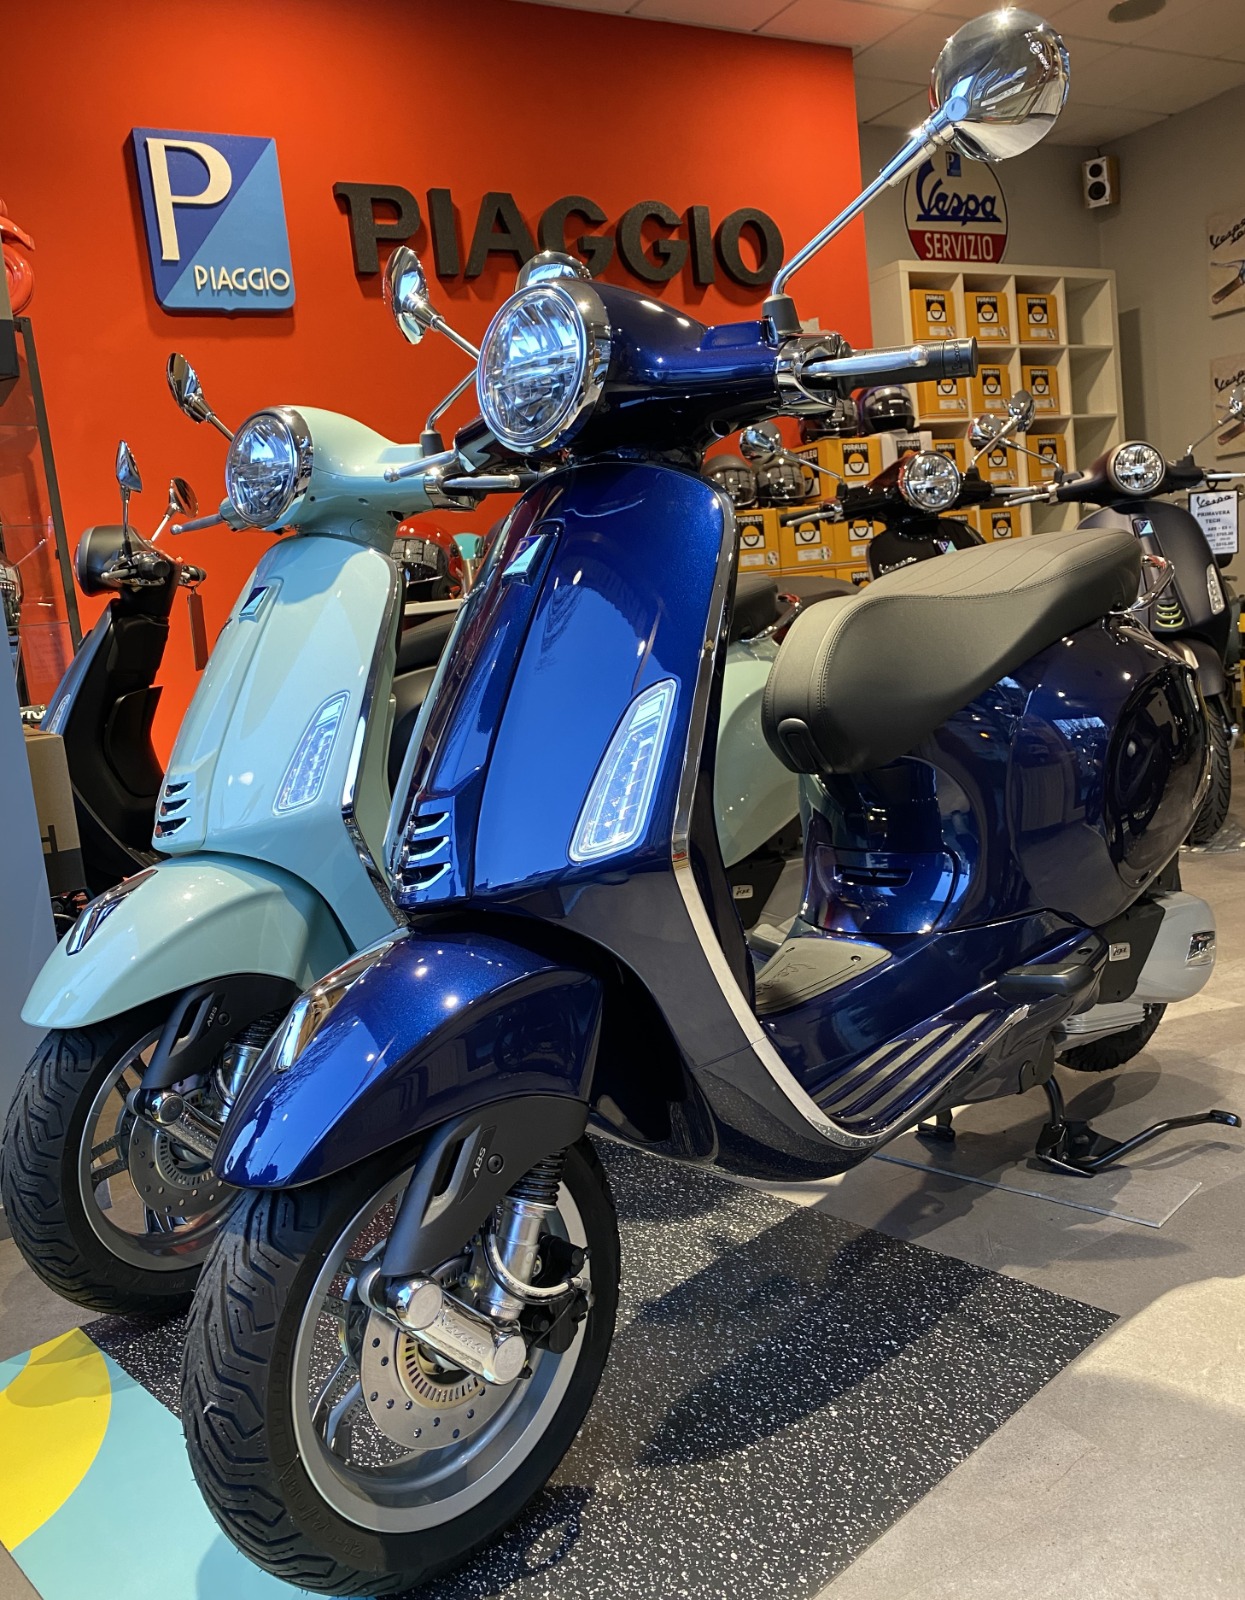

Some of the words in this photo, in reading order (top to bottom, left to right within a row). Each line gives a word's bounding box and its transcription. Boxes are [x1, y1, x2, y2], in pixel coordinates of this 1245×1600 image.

[146, 138, 232, 262] P
[915, 158, 1002, 227] Vespa
[332, 181, 785, 287] PIAGGIO
[924, 232, 994, 261] SERVIZIO
[193, 265, 291, 292] PIAGGIO
[1196, 494, 1234, 509] Vespa
[1197, 510, 1231, 518] PRIMAVERA
[510, 539, 530, 563] P
[206, 1006, 218, 1028] ABS
[473, 1146, 487, 1179] ABS
